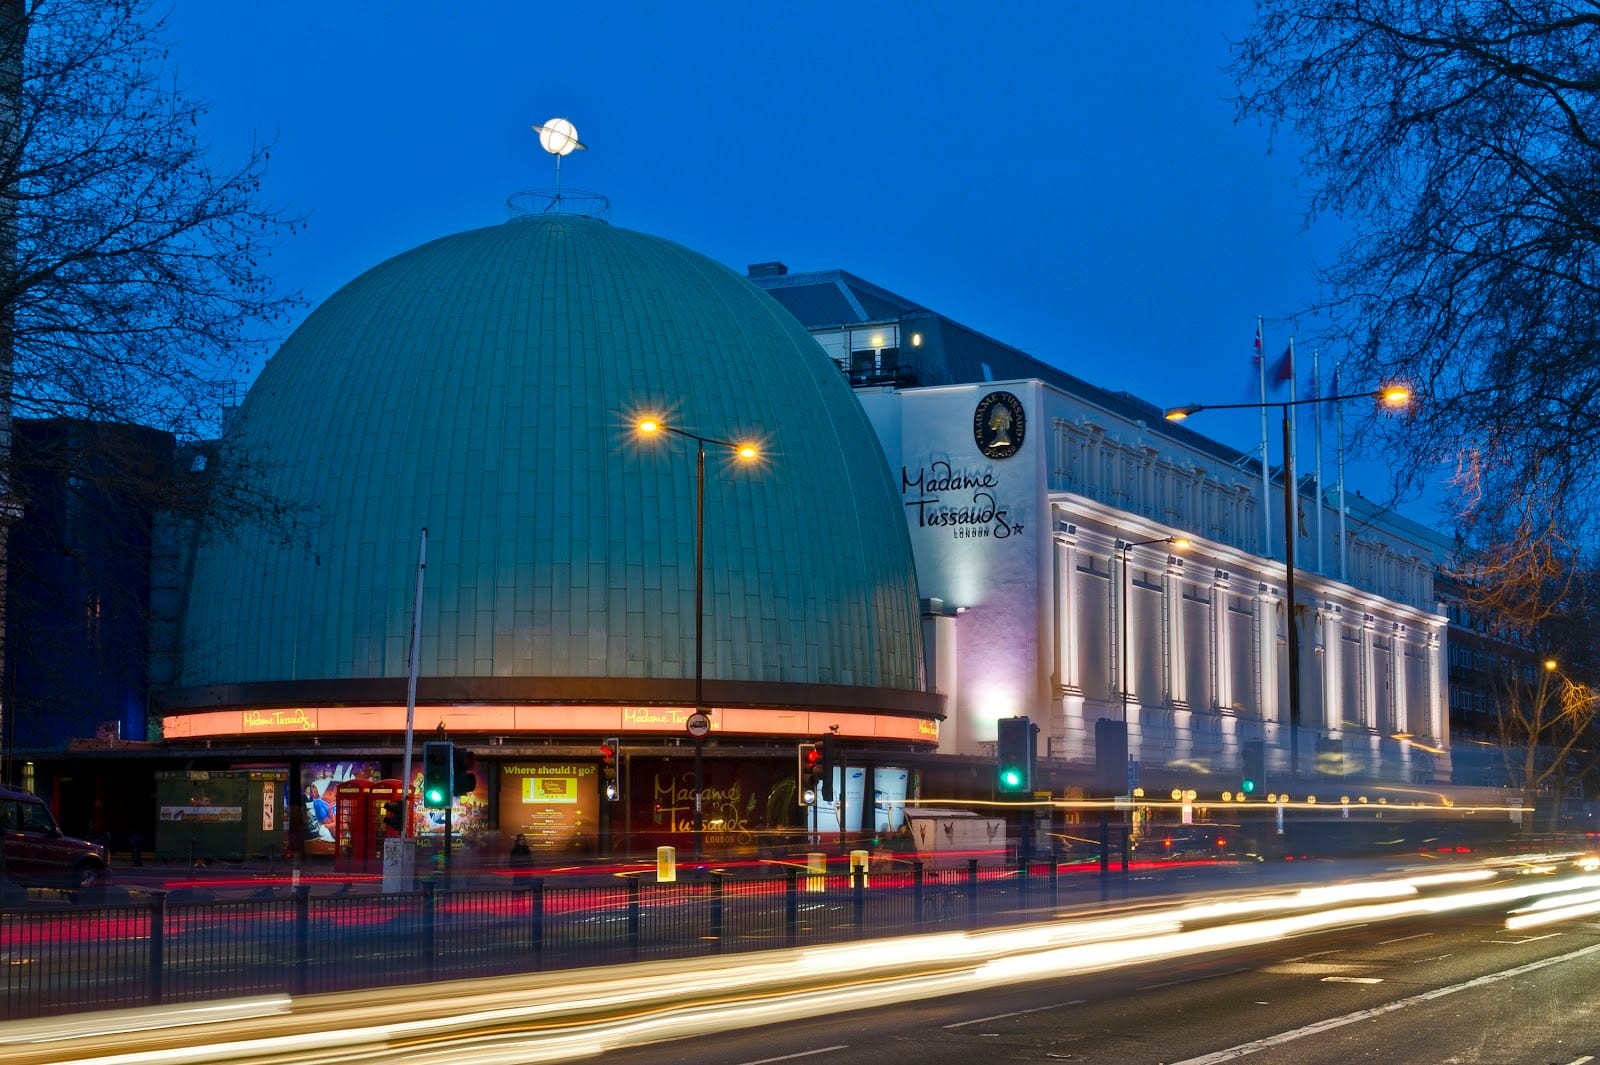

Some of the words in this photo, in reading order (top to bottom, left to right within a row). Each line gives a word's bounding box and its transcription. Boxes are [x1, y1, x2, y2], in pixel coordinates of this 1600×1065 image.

[975, 394, 997, 439] MADAME
[1000, 394, 1023, 437] TUSSAUD
[902, 461, 999, 497] Madame
[905, 493, 1011, 539] Tussauds
[953, 527, 989, 539] LONDON
[243, 711, 275, 728] Madame
[624, 707, 669, 724] Madame
[504, 766, 536, 775] Where
[537, 766, 570, 775] should
[572, 767, 577, 775] I
[578, 766, 597, 777] go?
[705, 835, 736, 844] LONDON
